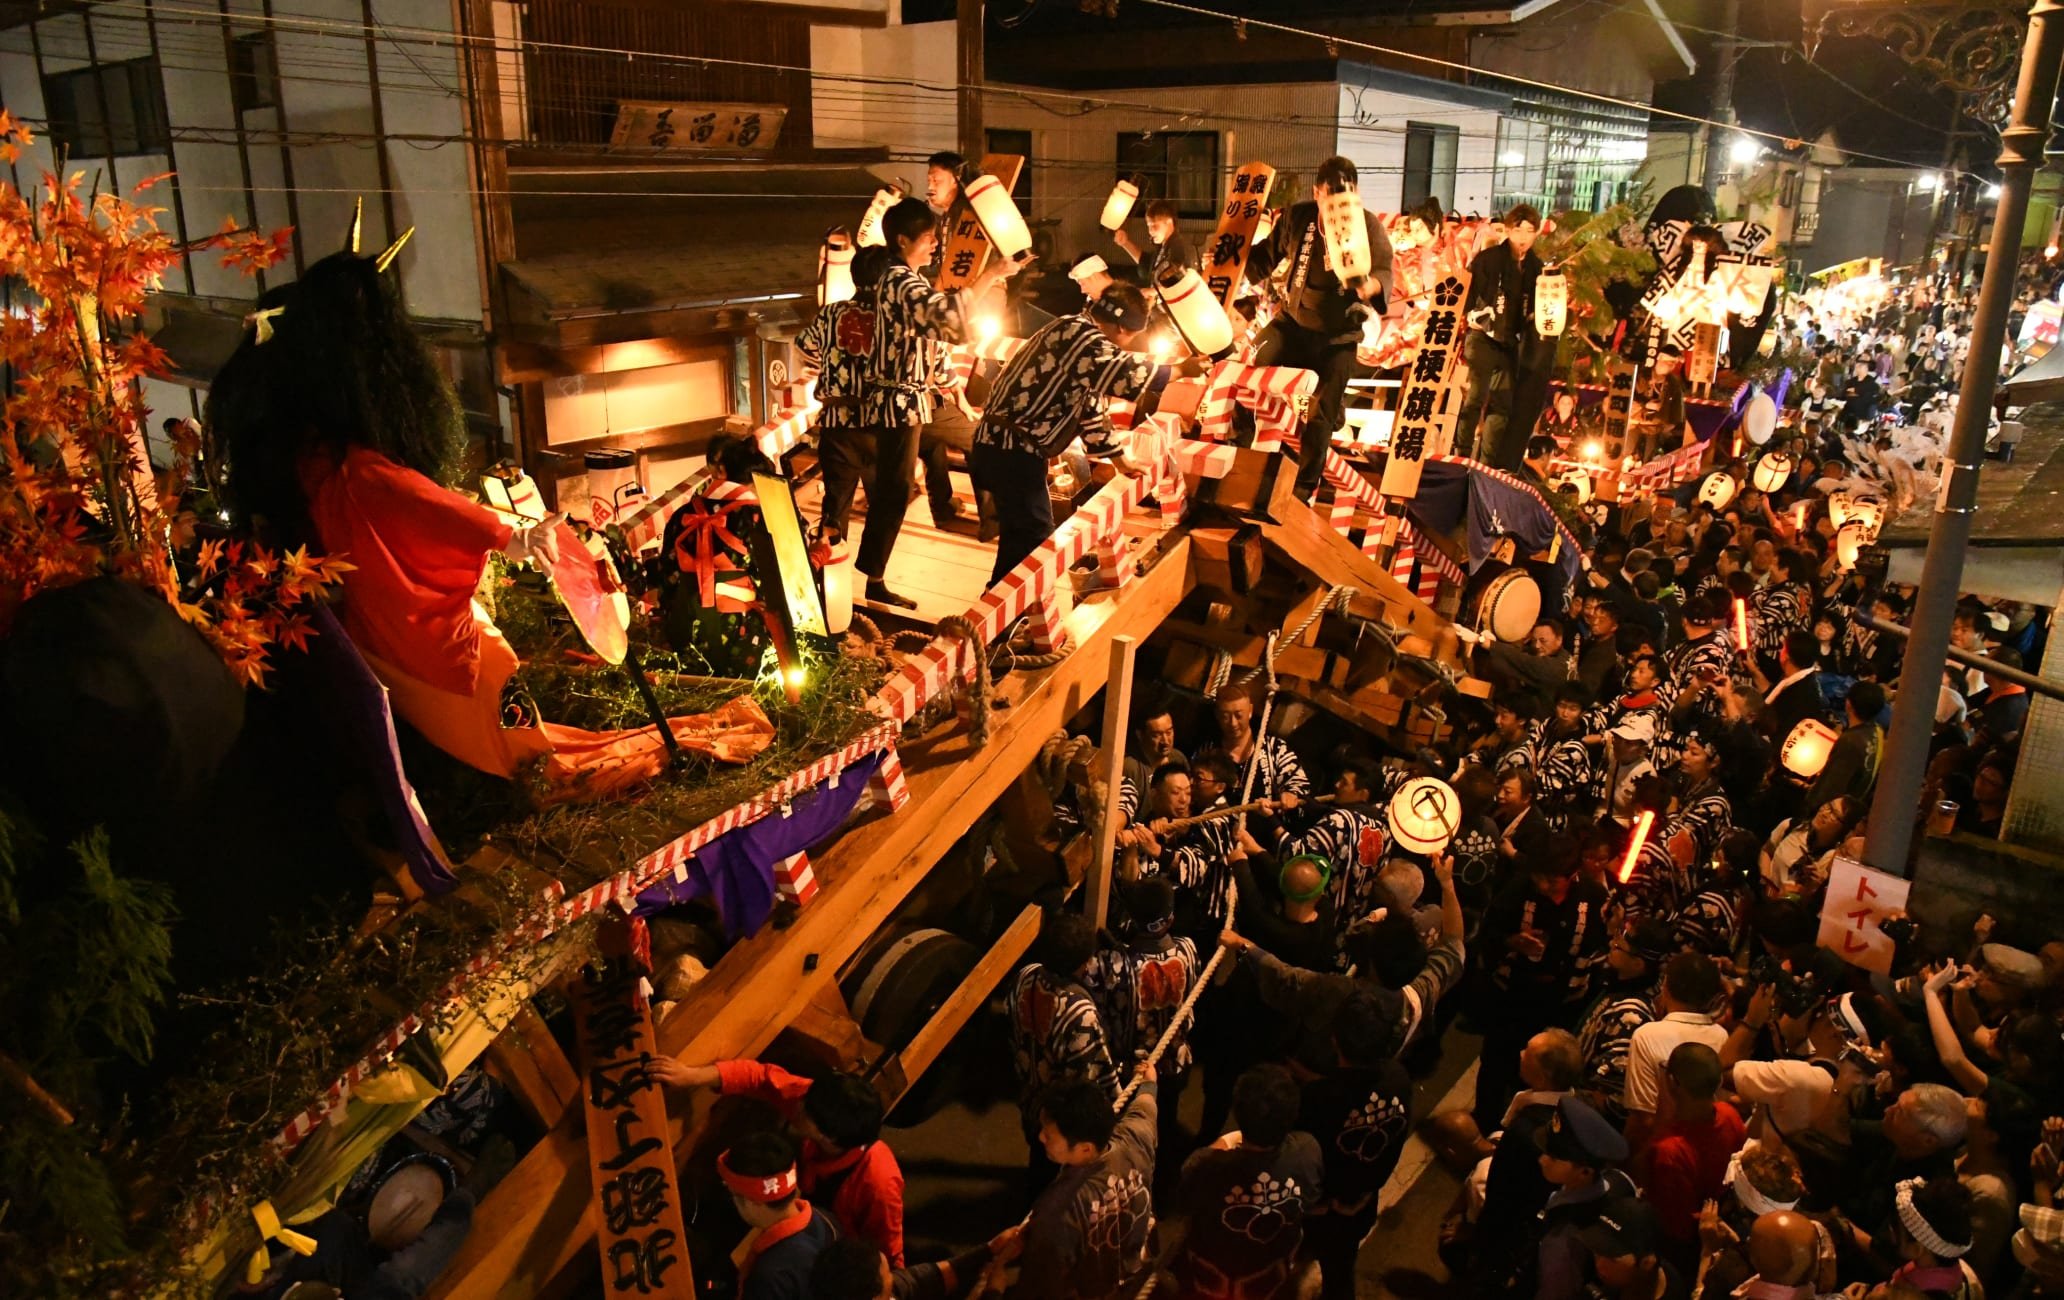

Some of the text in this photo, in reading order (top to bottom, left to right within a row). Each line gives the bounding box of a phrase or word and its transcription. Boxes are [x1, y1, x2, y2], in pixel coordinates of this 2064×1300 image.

[1394, 309, 1457, 463] 桔梗旗揚
[1604, 372, 1633, 460] 本町通り
[1844, 876, 1879, 954] トイレ
